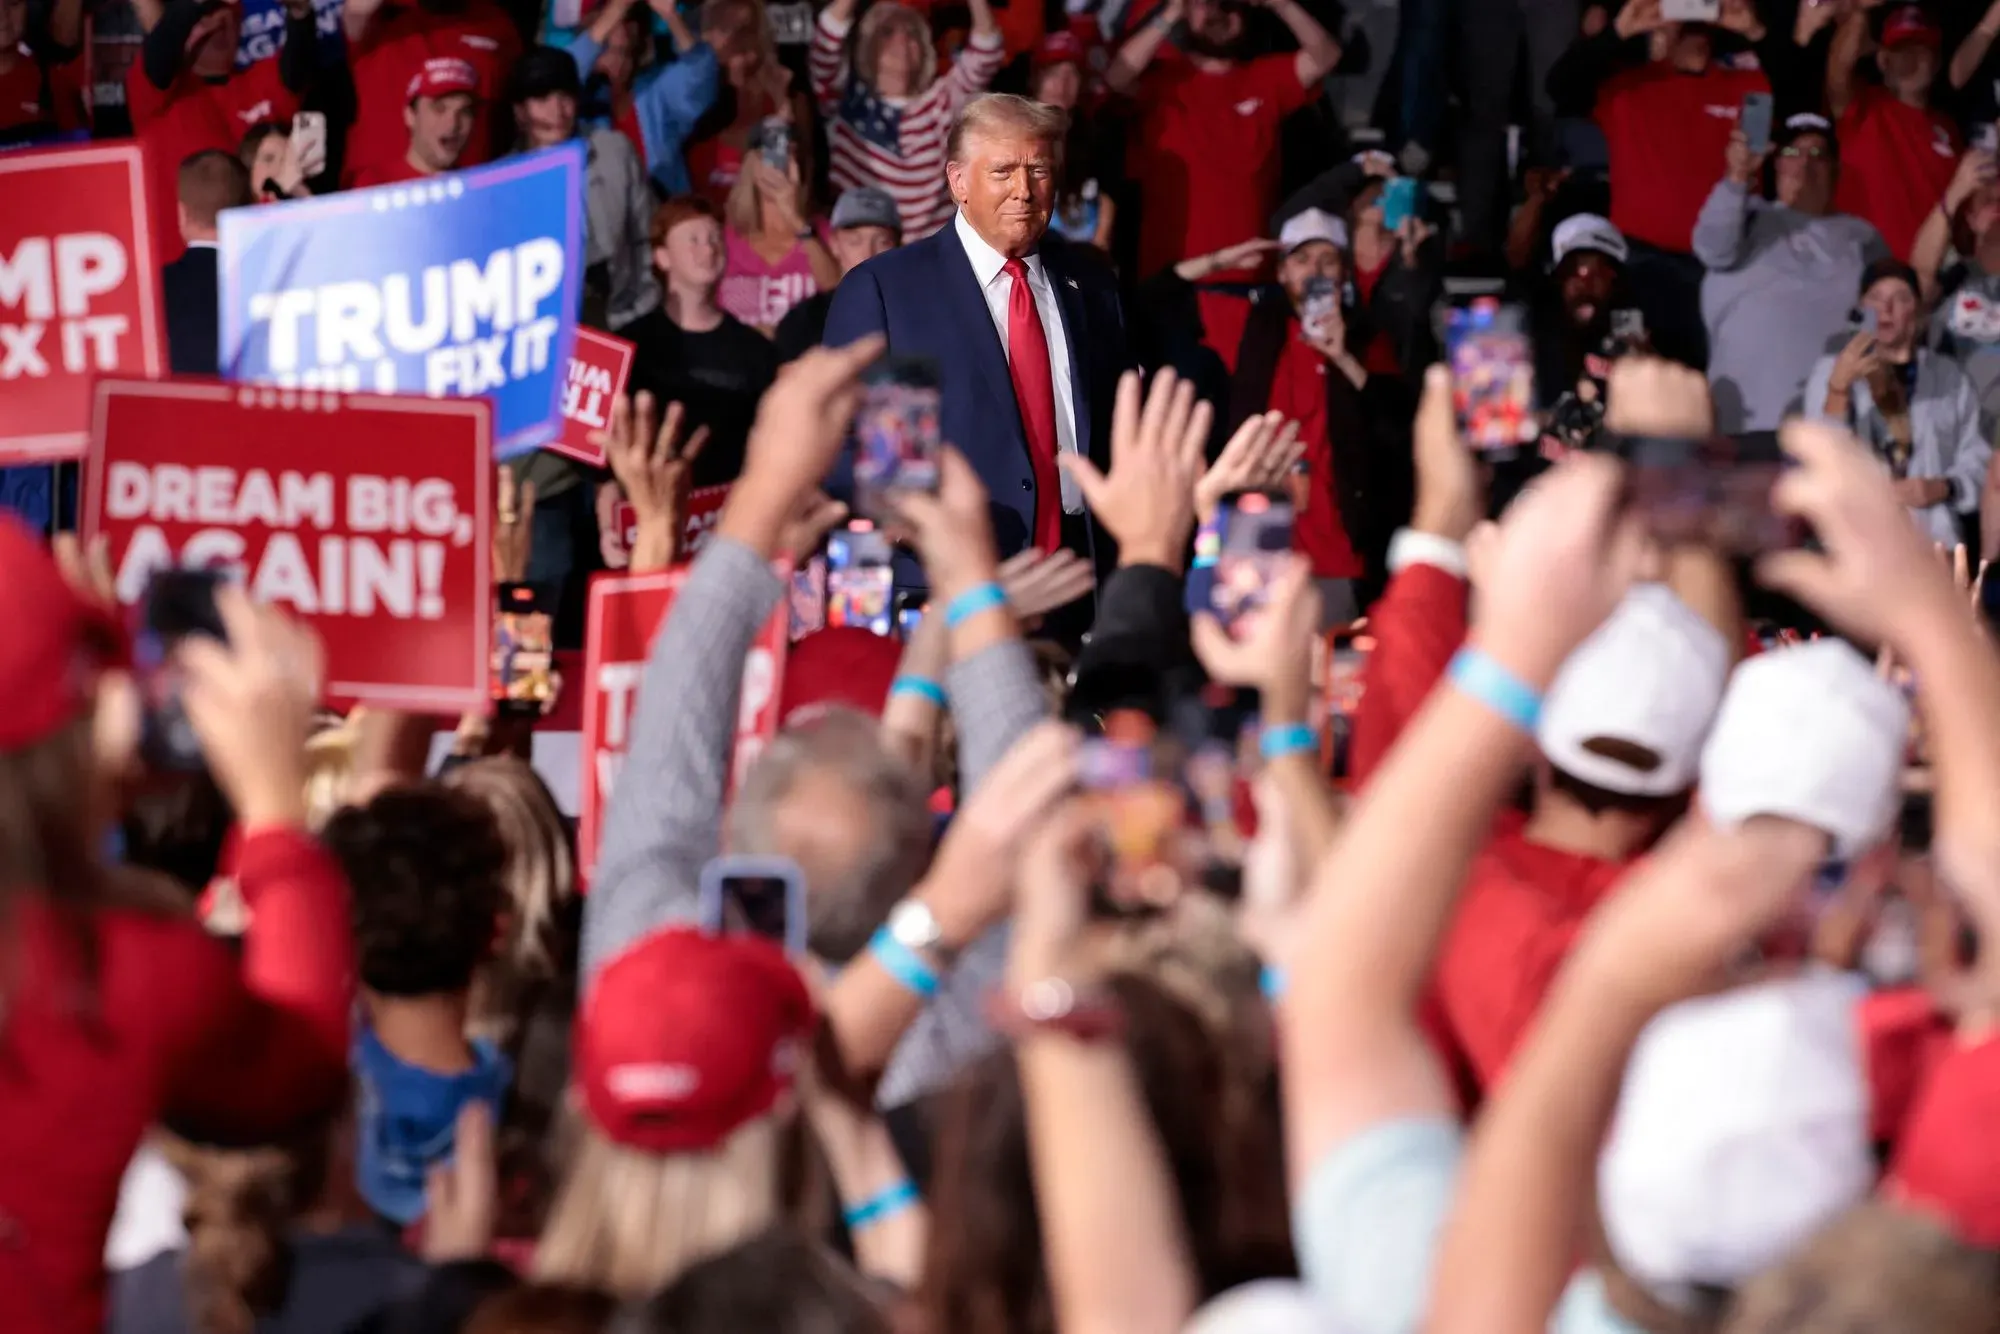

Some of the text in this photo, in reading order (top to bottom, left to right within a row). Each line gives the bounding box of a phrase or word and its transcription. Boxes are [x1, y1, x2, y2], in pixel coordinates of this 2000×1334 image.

[62, 314, 129, 373] IT
[249, 237, 564, 372] TRUMP
[426, 333, 506, 397] FIX
[511, 315, 557, 380] IT
[105, 460, 474, 547] DREAM BIG,
[116, 524, 446, 619] AGAIN!
